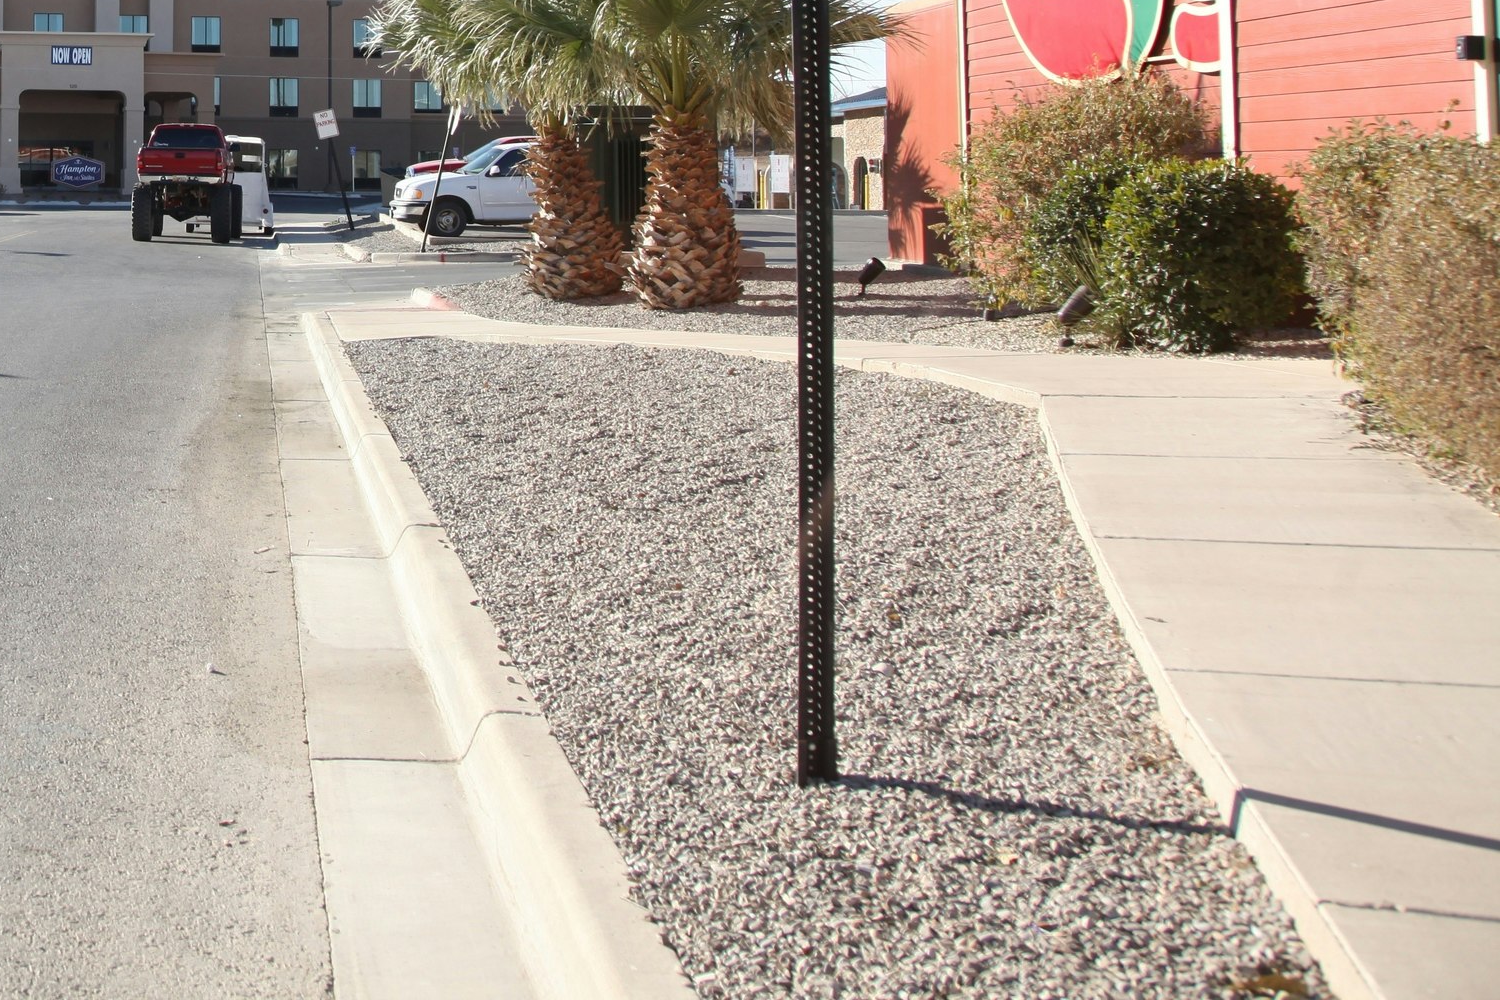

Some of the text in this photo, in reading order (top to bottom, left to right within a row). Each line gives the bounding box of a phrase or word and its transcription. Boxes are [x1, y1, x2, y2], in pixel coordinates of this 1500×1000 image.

[52, 47, 91, 64] NOW OPEN
[316, 119, 335, 127] PARKING
[55, 164, 101, 175] Hampton
